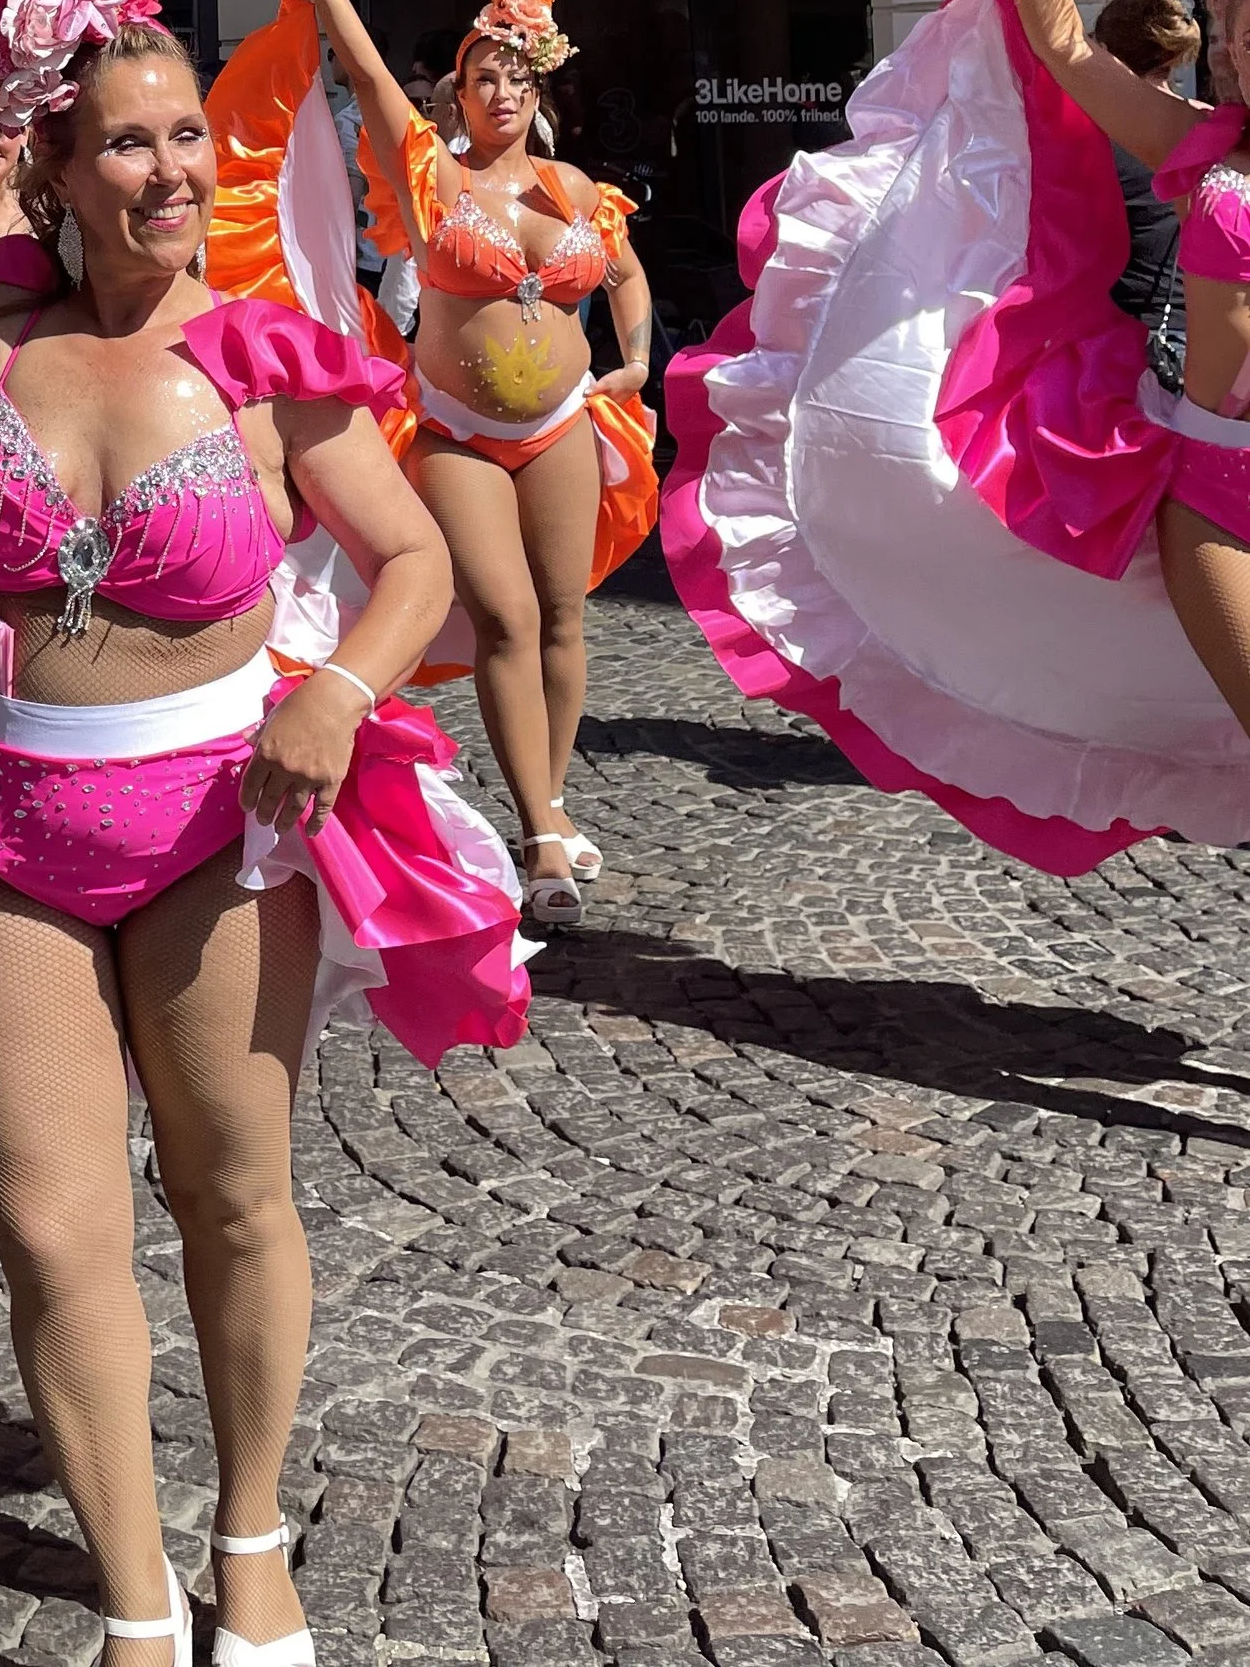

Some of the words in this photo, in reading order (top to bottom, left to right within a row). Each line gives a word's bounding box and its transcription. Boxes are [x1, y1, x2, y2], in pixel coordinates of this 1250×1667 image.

[694, 76, 842, 105] 3LikeHome
[695, 109, 718, 124] 100
[721, 108, 759, 124] lande.
[761, 108, 797, 123] 100%
